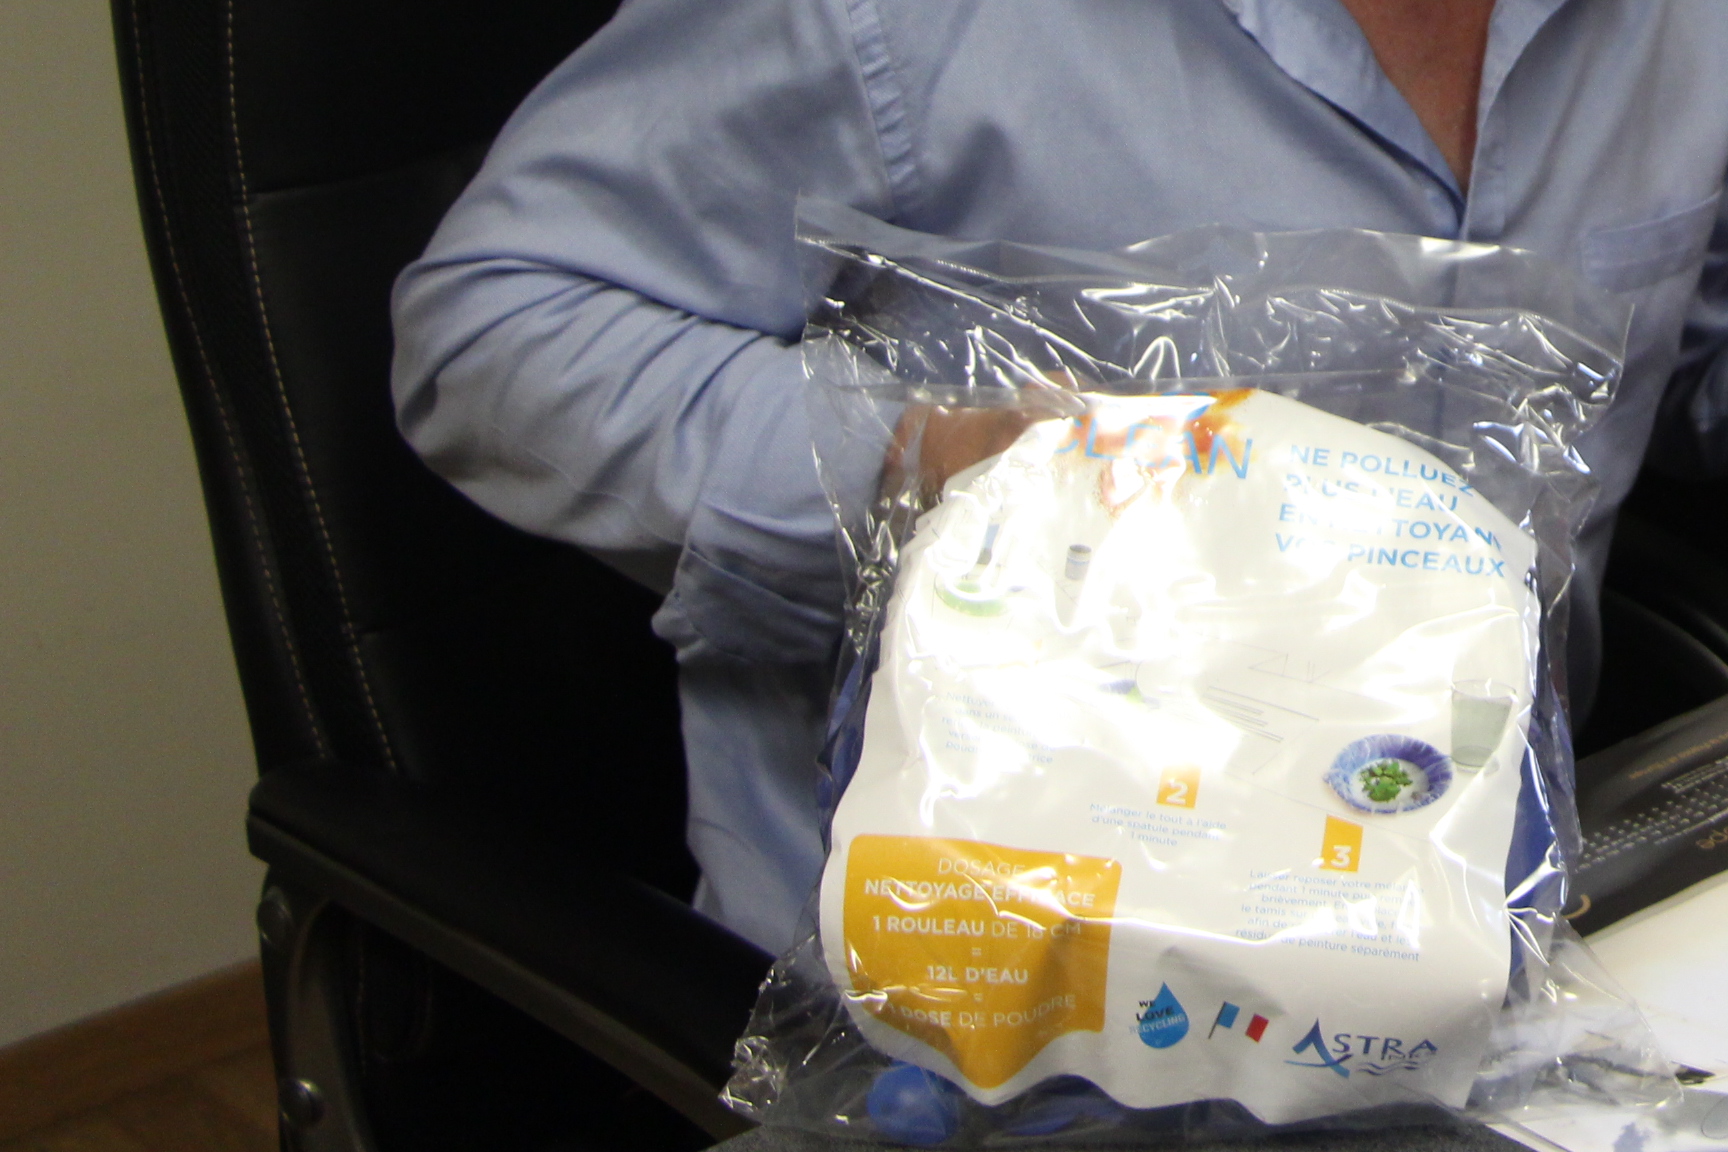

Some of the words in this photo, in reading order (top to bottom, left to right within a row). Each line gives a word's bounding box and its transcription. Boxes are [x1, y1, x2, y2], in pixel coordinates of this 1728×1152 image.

[1290, 444, 1331, 467] NE
[1340, 451, 1474, 498] POLLUEZ
[1347, 543, 1507, 579] PINCEAUX
[1166, 780, 1189, 805] 2
[1091, 813, 1125, 827] d'une
[1126, 819, 1170, 835] spatule
[1146, 810, 1157, 821] le
[1159, 812, 1183, 825] tout
[1196, 817, 1228, 830] l'aide
[1137, 832, 1179, 847] minute
[1330, 843, 1353, 869] 3
[937, 857, 1026, 878] DOSAGE
[1293, 874, 1338, 889] reposer
[1341, 879, 1372, 890] votre
[864, 878, 984, 901] NETTOYAGE
[992, 884, 1097, 909] EFFACE
[1308, 886, 1350, 900] minute
[1254, 905, 1287, 917] tamis
[873, 915, 881, 932] 1
[887, 915, 985, 937] ROULEAU
[991, 920, 1018, 939] DE
[1235, 928, 1272, 941] résid
[1298, 935, 1349, 953] peinture
[1350, 944, 1421, 962] séparément
[1380, 933, 1394, 944] et
[926, 965, 957, 982] 12L
[965, 966, 1030, 985] D'EAU
[901, 1005, 953, 1028] DOSE
[958, 1010, 987, 1029] DE
[993, 993, 1078, 1029] POUDRE
[1135, 1005, 1175, 1022] LOVE
[1138, 999, 1156, 1009] WE
[1283, 1017, 1439, 1079] ASTRA
